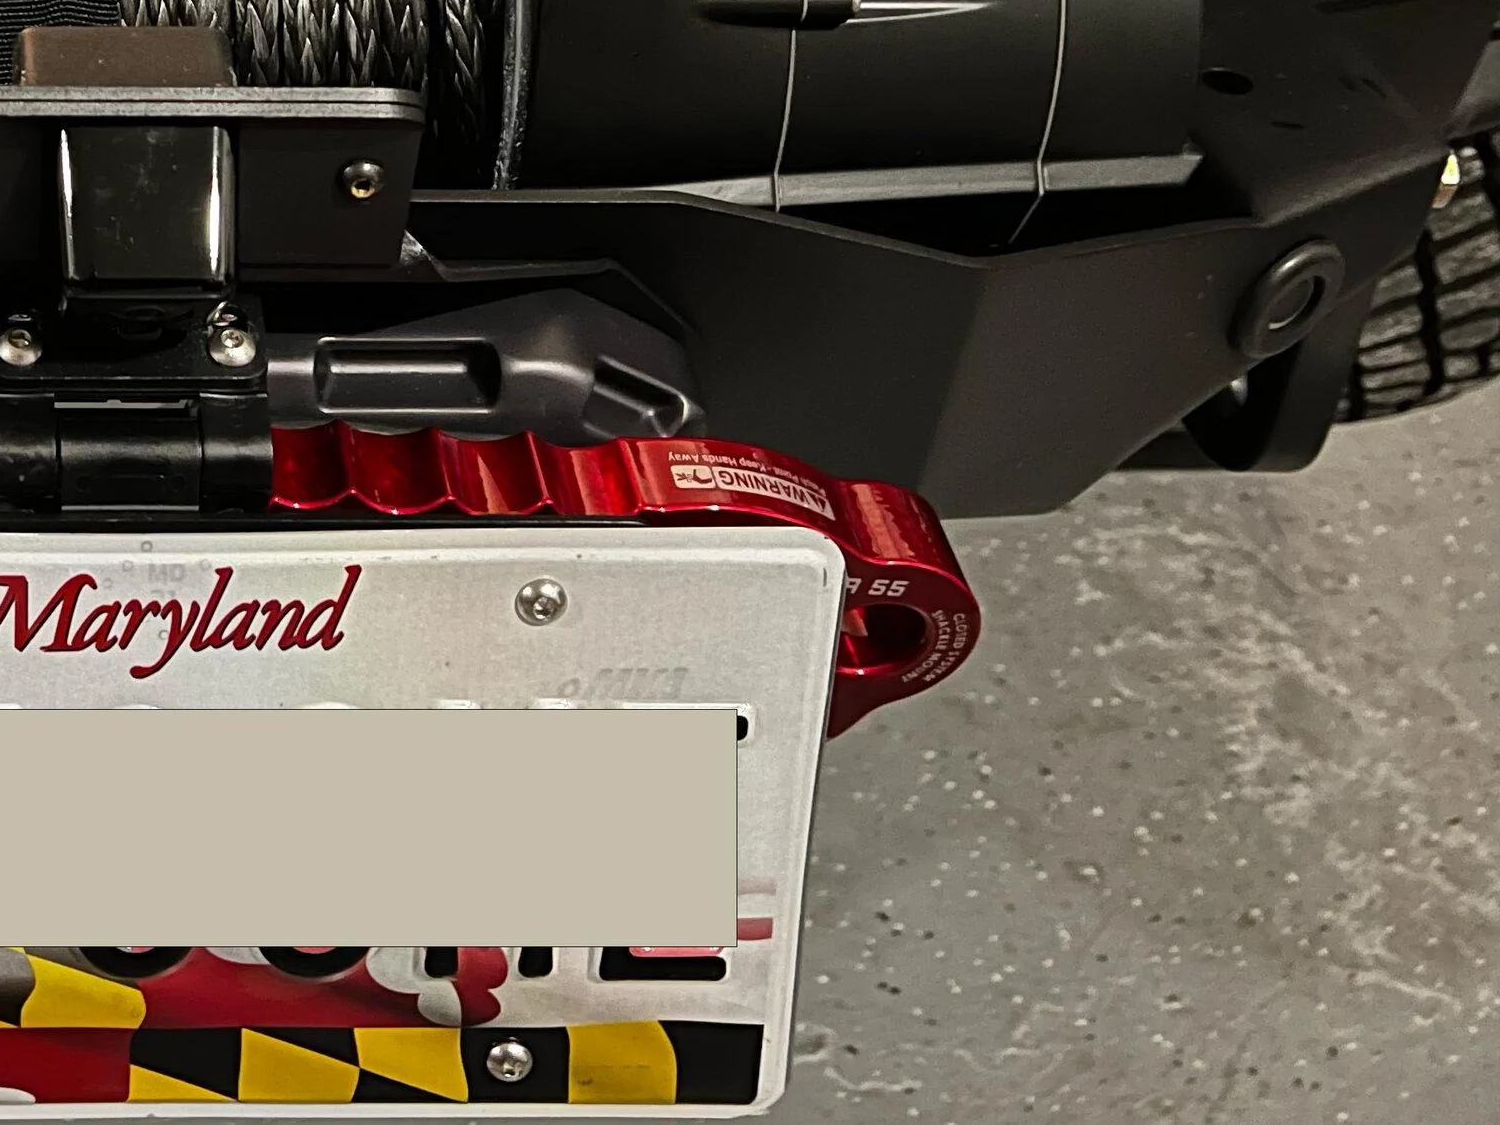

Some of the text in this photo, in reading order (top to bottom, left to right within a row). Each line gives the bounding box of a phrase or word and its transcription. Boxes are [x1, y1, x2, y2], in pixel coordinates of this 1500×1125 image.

[668, 451, 699, 463] Away
[701, 454, 738, 467] Hands
[717, 470, 810, 507] WARNING
[867, 579, 911, 597] 55
